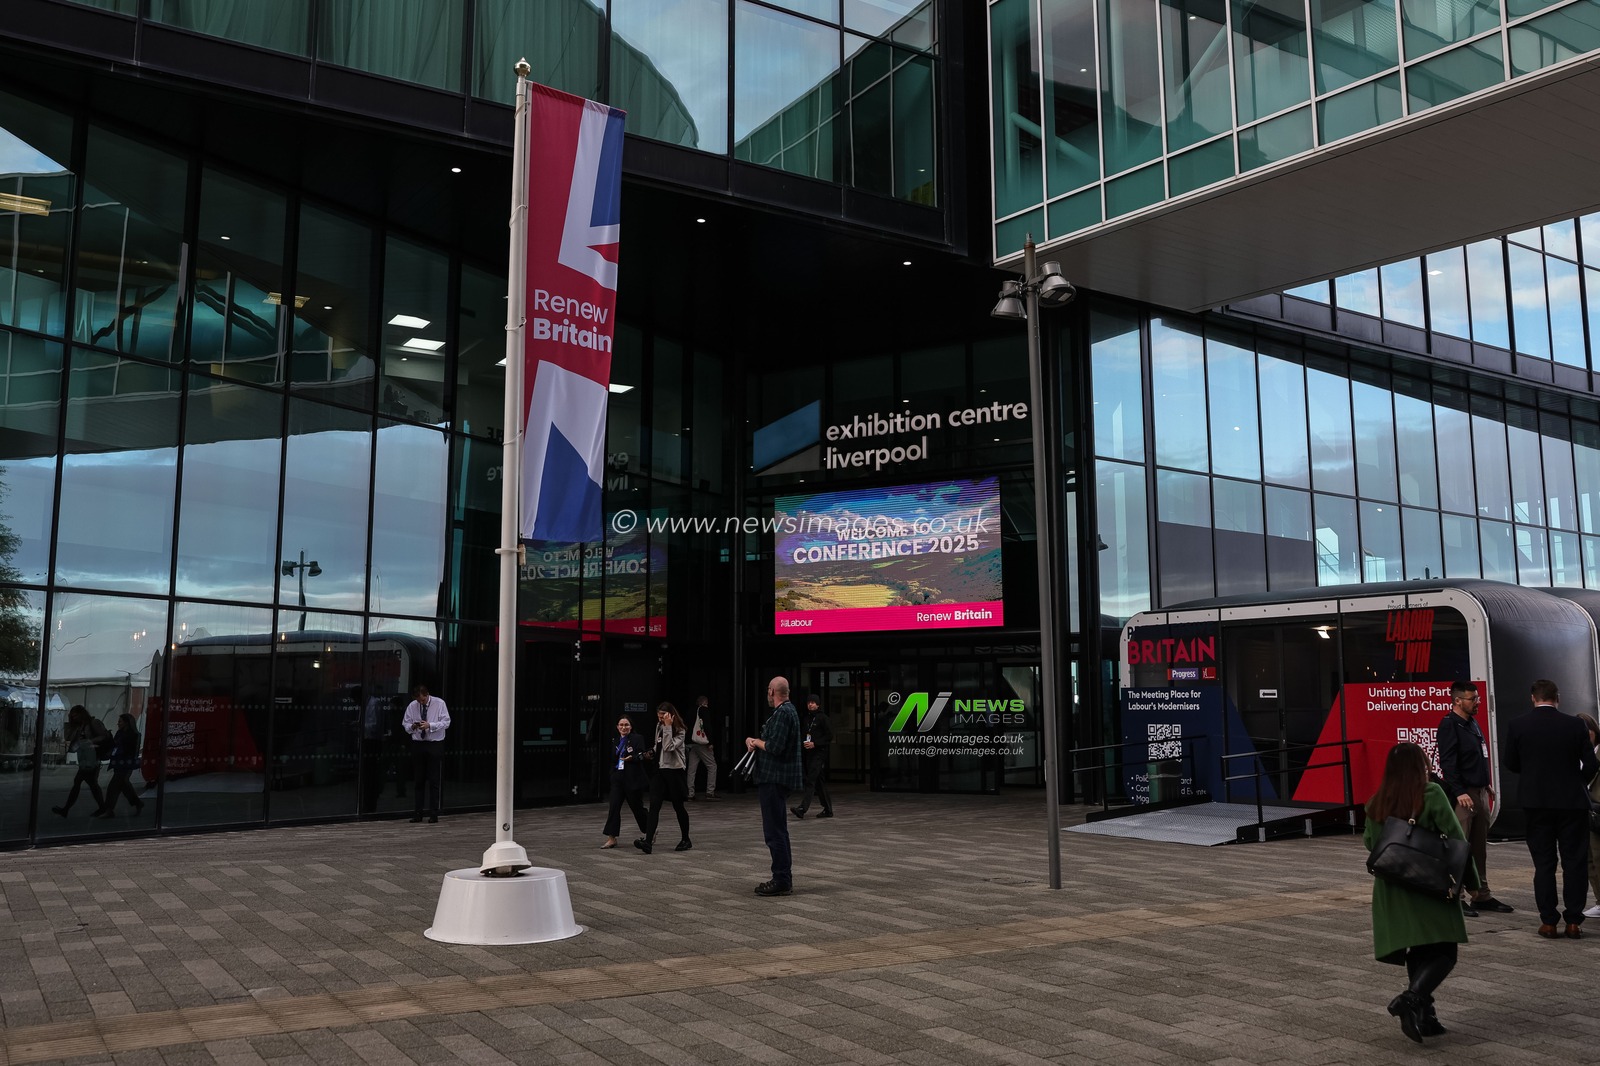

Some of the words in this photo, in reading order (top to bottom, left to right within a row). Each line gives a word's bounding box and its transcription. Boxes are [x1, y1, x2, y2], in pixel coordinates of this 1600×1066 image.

[534, 289, 608, 324] Renew
[533, 317, 612, 353] Britain
[826, 410, 940, 441] exhibition
[948, 401, 1028, 427] centre
[826, 436, 927, 471] liverpool
[837, 524, 909, 541] WELCOME
[912, 522, 930, 536] TO
[793, 538, 922, 564] CONFERENCE
[928, 534, 979, 554] 2025
[786, 618, 813, 627] Labour
[916, 612, 952, 622] Renew
[954, 609, 992, 620] Britain
[1386, 608, 1434, 642] LABOUR
[1128, 636, 1215, 664] BRITAIN
[1395, 642, 1404, 660] TO
[1405, 641, 1432, 673] WIN
[1172, 669, 1196, 679] Progress
[1128, 690, 1140, 699] The
[1141, 690, 1169, 700] Meeting
[1170, 690, 1190, 698] Place
[1190, 690, 1201, 698] for
[1368, 687, 1406, 699] Uniting
[1408, 686, 1426, 697] the
[1429, 686, 1452, 697] Part
[1128, 702, 1156, 710] Labour's
[1157, 702, 1200, 710] Modernisers
[1367, 700, 1419, 713] Delivering
